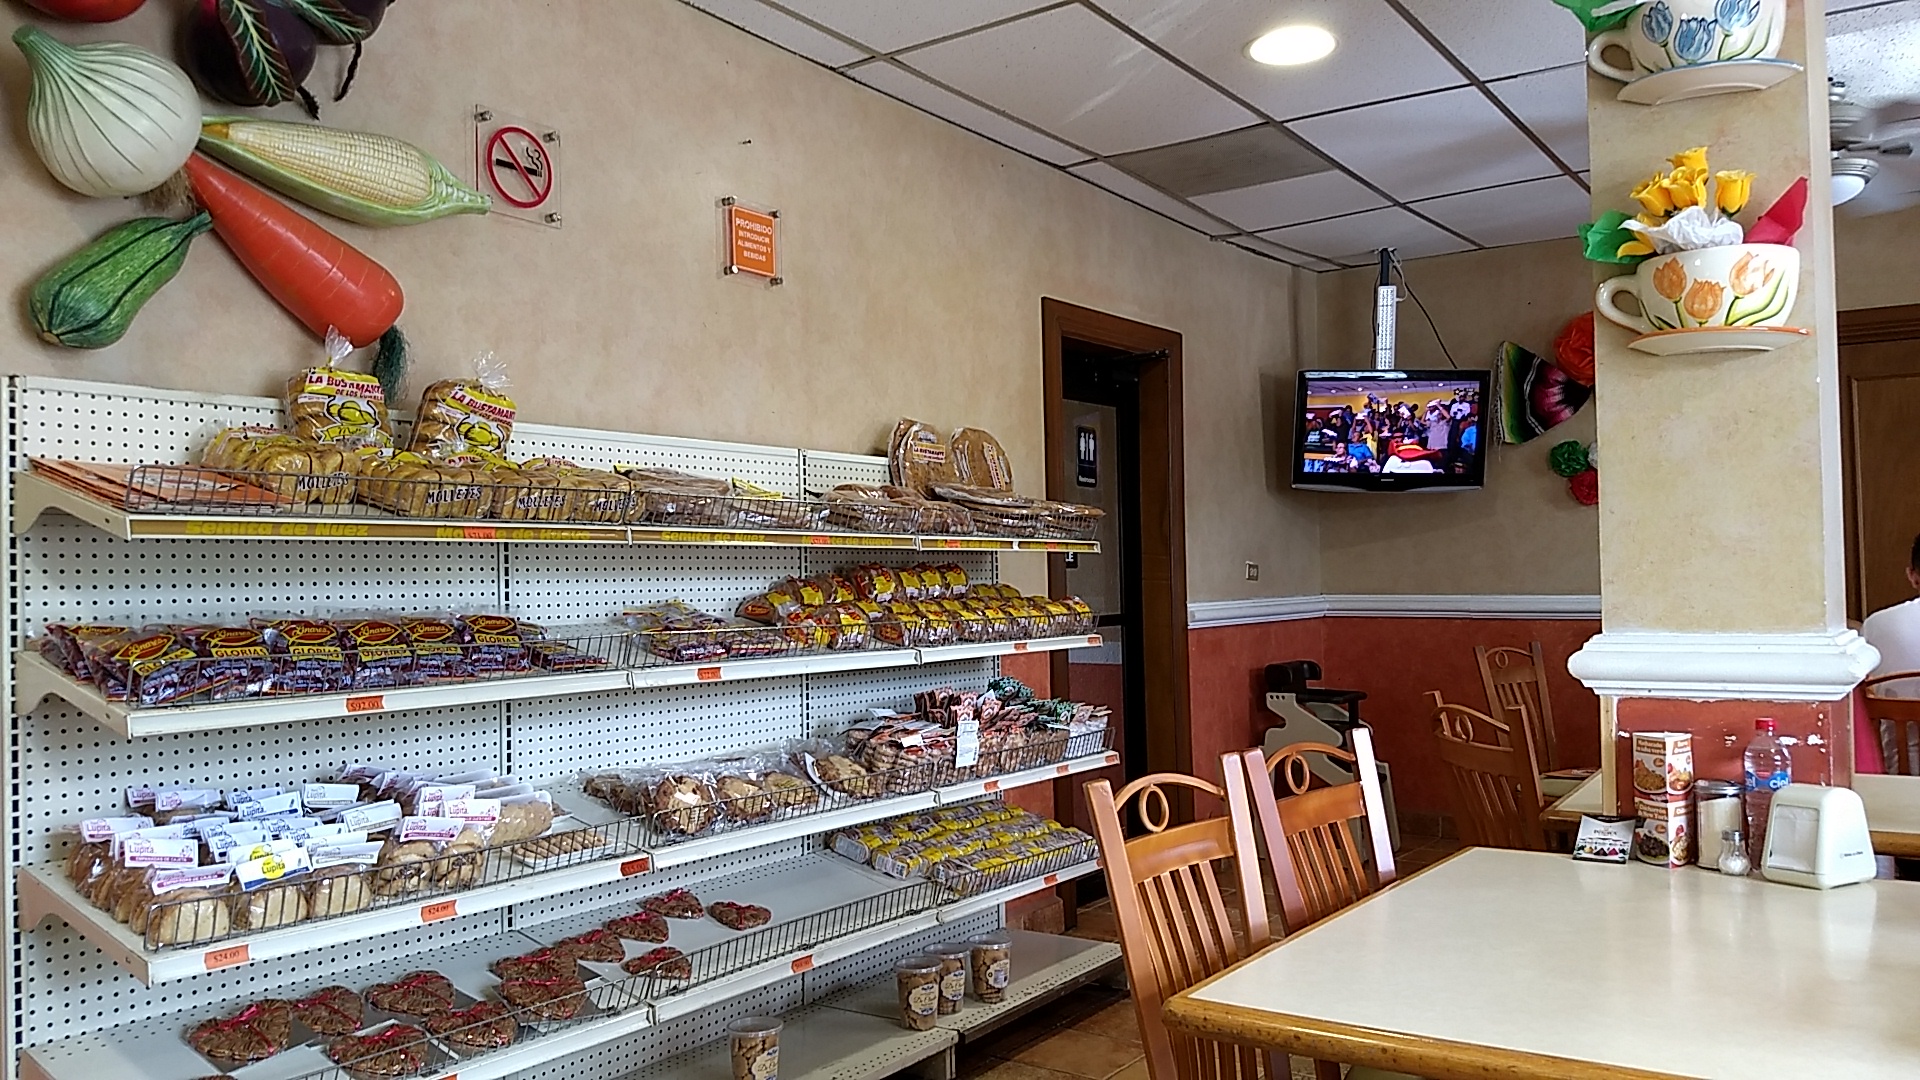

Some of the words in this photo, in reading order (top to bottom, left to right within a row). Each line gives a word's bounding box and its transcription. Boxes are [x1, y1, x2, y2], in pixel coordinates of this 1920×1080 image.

[735, 217, 773, 235] PROHIBIDO
[738, 229, 770, 244] INTRODUCIR
[738, 239, 767, 253] ALIMENTOS
[767, 246, 772, 254] Y
[743, 250, 767, 262] BEBIDAS
[307, 375, 324, 384] LA
[450, 391, 466, 404] LA
[426, 485, 481, 504] MOLLETES
[516, 494, 566, 509] MOLLETES
[185, 521, 273, 535] Semita
[279, 521, 308, 535] de
[314, 523, 369, 537] Nuez
[512, 528, 534, 540] de
[660, 531, 711, 542] Semita
[714, 532, 732, 542] de
[734, 533, 766, 543] Nuez
[845, 536, 860, 545] de
[861, 537, 893, 546] Huevo
[292, 624, 330, 636] Linares
[360, 626, 395, 636] Linares
[413, 624, 448, 634] Linares
[477, 634, 518, 644] GLORIAS
[215, 647, 268, 658] GLORIAS
[292, 647, 339, 659] GLORIAS
[350, 701, 379, 711] $92.00
[1769, 776, 1789, 789] ciel
[131, 791, 156, 800] Lupita
[307, 790, 326, 799] Lupita
[232, 796, 253, 805] Lupita
[242, 806, 265, 817] Lupita
[449, 806, 468, 815] Lupita
[350, 816, 369, 827] Lupita
[86, 823, 111, 833] Lupita
[268, 823, 291, 834] Lupita
[406, 823, 427, 832] Lupita
[129, 844, 154, 855] Lupita
[215, 839, 238, 850] Lupita
[261, 861, 286, 874] Lupita
[214, 950, 240, 962] $24.00
